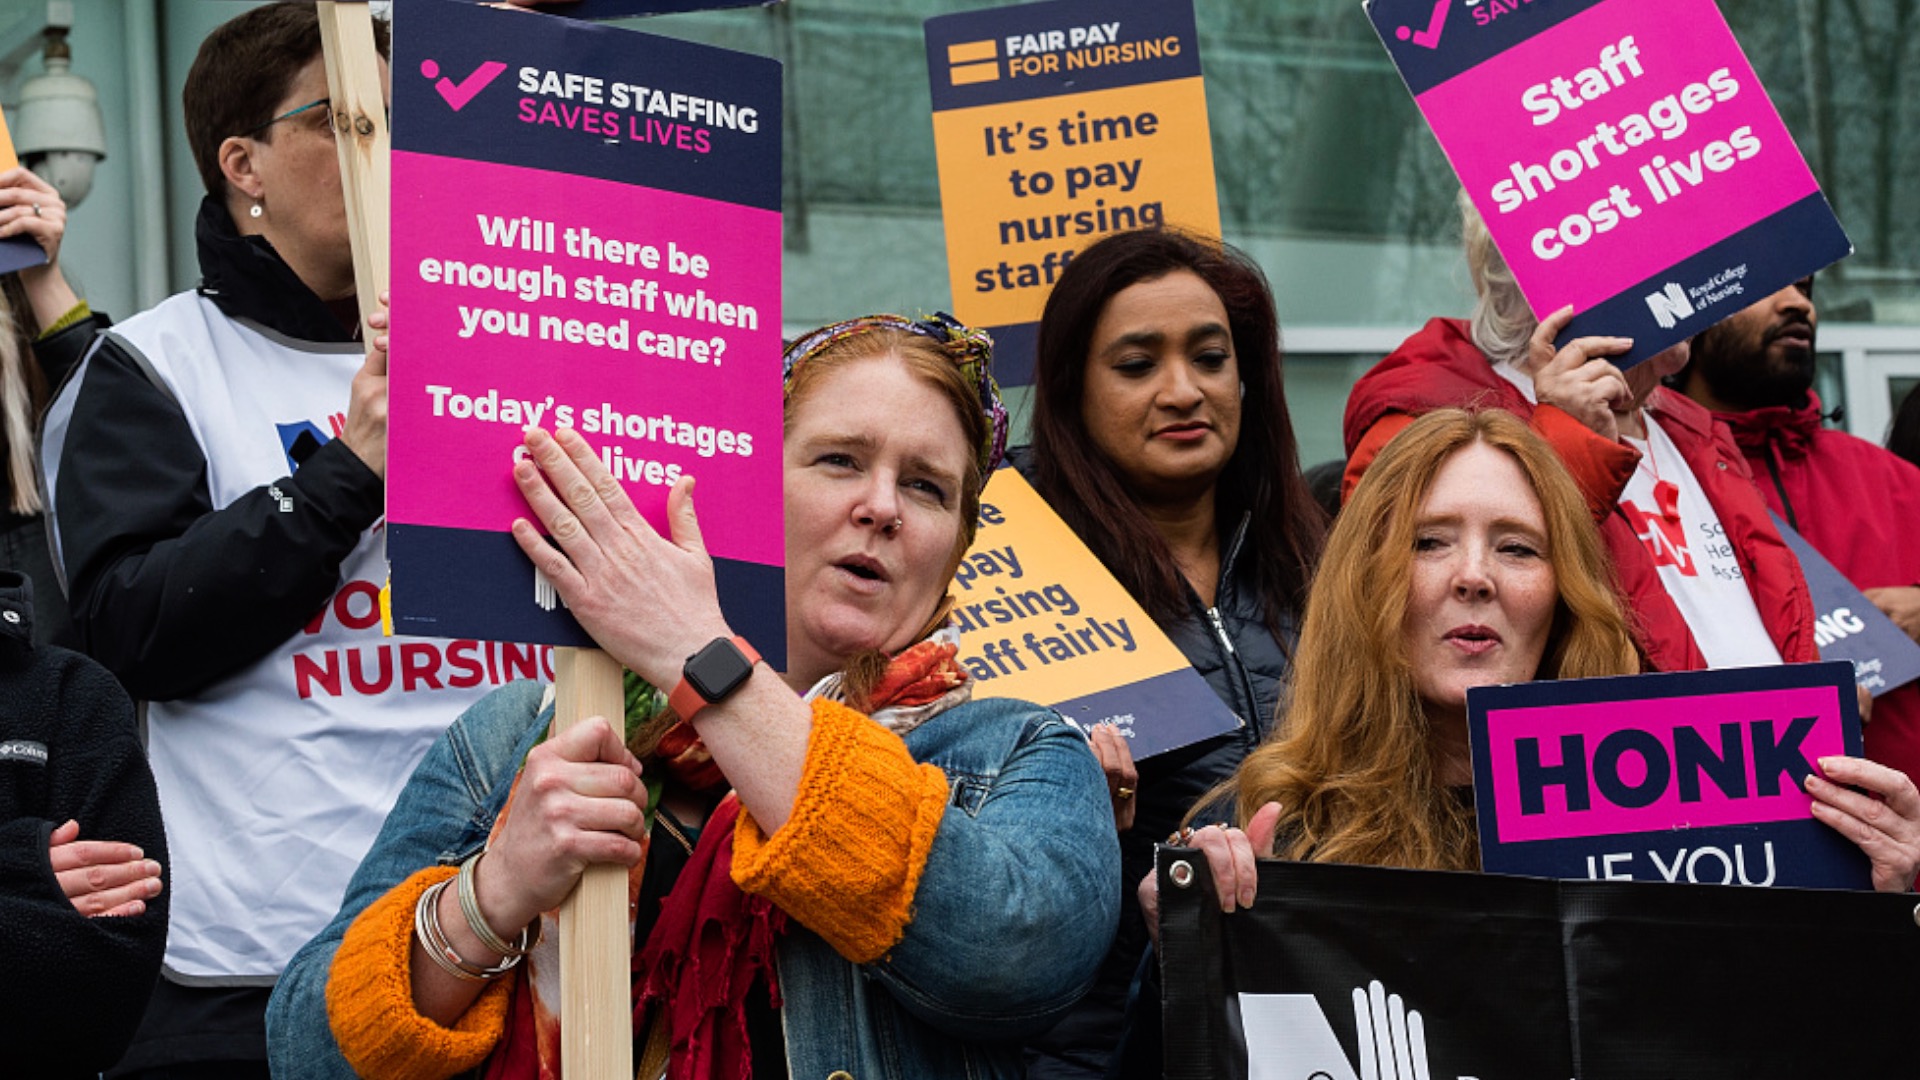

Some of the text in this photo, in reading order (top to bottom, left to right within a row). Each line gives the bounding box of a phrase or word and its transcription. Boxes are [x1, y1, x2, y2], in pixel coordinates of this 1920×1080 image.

[1006, 22, 1121, 57] FAIR PAY
[1009, 36, 1181, 78] FOR NURSING
[517, 66, 759, 134] SAFE STAFFING
[1520, 35, 1645, 126] Staff
[518, 98, 712, 154] SAVES LIVES
[984, 111, 1159, 156] It’s time
[1490, 67, 1740, 213] shortages
[1009, 159, 1143, 199] to pay
[1531, 125, 1762, 260] cost lives
[477, 214, 709, 278] Will there be
[999, 199, 1164, 244] nursing
[419, 258, 758, 330] enough staff when
[458, 306, 727, 367] you need care?
[426, 384, 574, 432] Today’s
[582, 402, 754, 457] shortages
[955, 544, 1023, 590] pay
[952, 584, 1080, 633] ursing
[963, 617, 1137, 681] aff fairly
[1514, 716, 1819, 816] HONK
[1648, 841, 1776, 887] YOU
